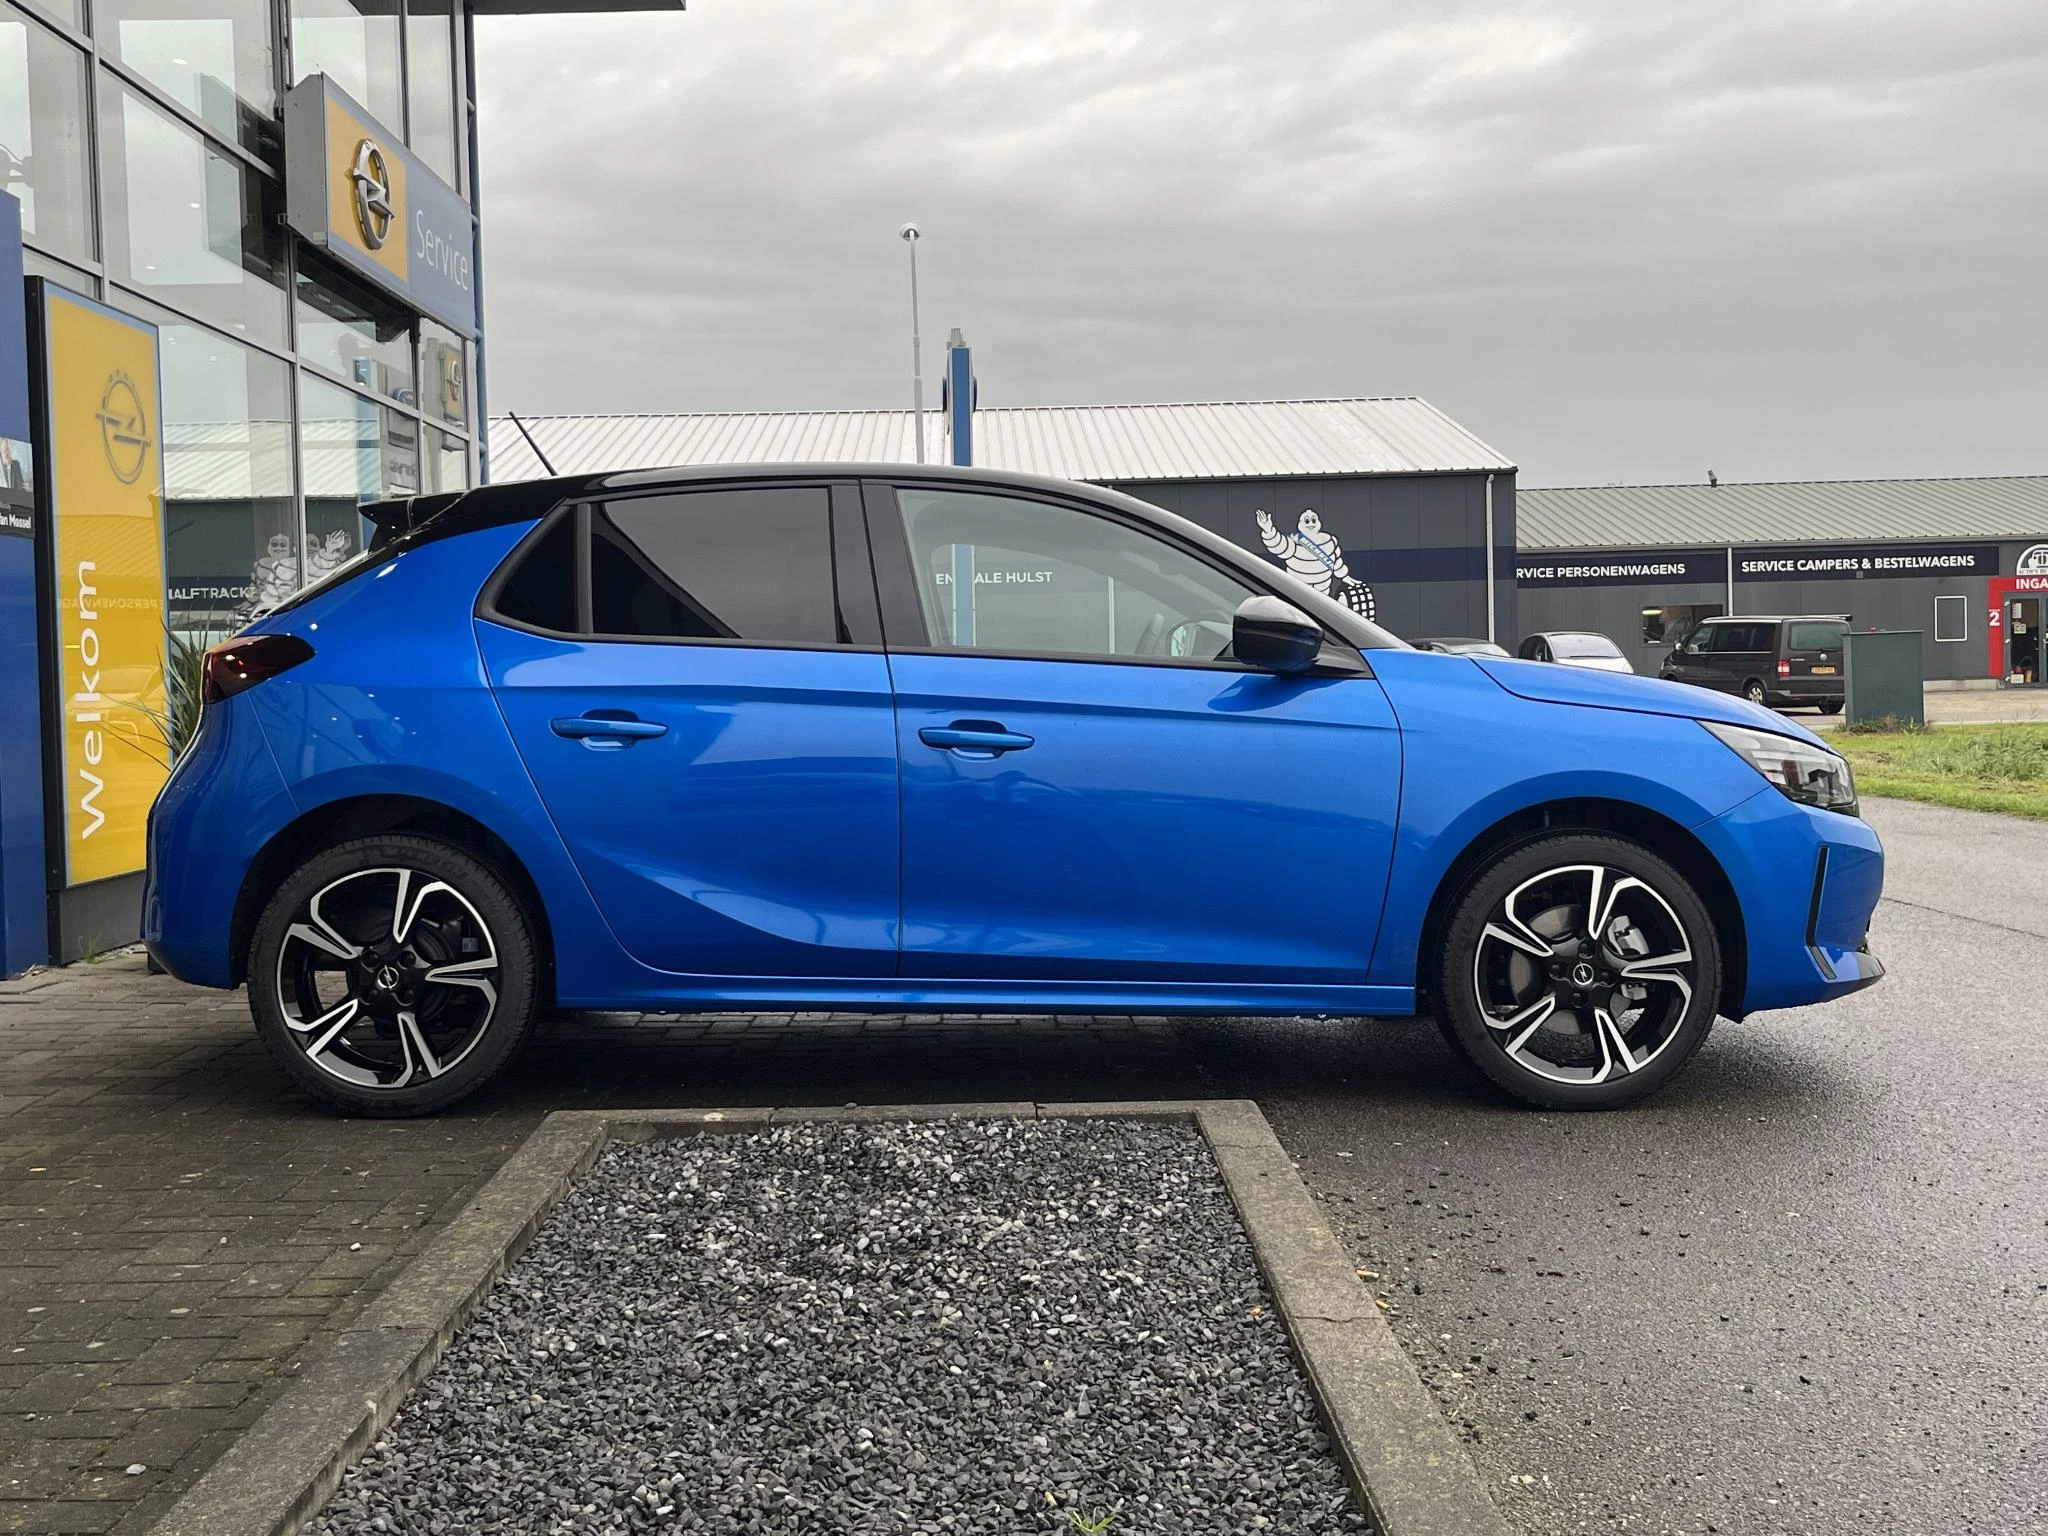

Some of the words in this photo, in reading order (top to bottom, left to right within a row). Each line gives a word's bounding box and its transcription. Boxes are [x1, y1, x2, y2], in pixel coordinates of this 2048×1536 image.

[416, 209, 468, 291] Service
[0, 512, 8, 526] an
[9, 513, 31, 529] Mossel
[1557, 563, 1686, 578] PERSONENWAGENS
[1741, 559, 1794, 572] SERVICE
[1797, 557, 1859, 571] CAMPERS
[1861, 557, 1871, 569] &
[1874, 555, 1975, 569] BESTELWAGENS
[1006, 571, 1053, 584] HULST
[1989, 611, 2000, 627] 2
[76, 561, 105, 840] Welkom
